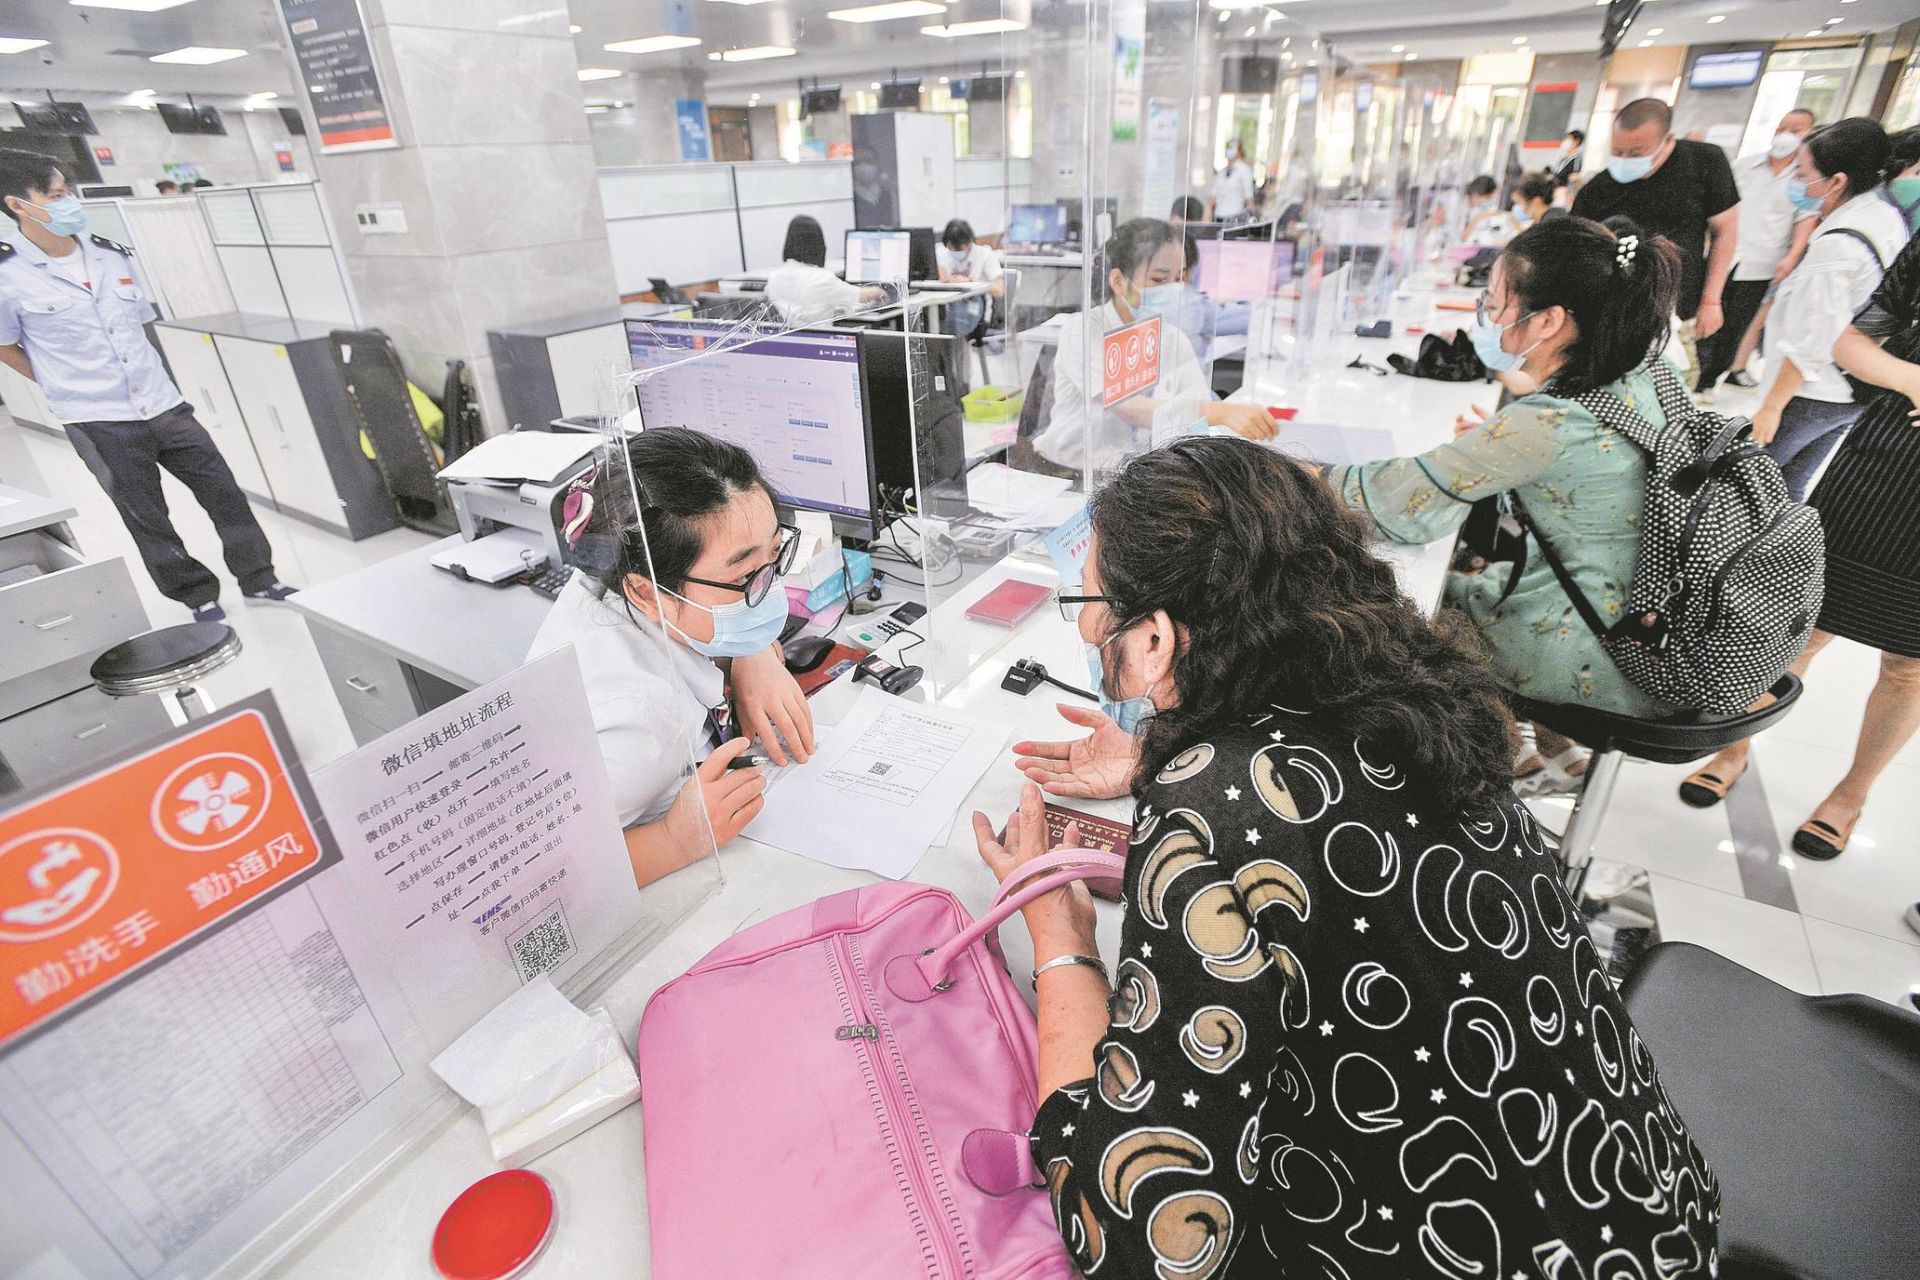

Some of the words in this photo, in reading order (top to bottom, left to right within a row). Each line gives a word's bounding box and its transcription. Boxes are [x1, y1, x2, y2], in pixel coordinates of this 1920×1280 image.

[381, 691, 515, 777] 微信填地址流程
[488, 758, 531, 789] 填写姓名
[356, 782, 421, 824] 微信扫一扫
[448, 731, 503, 770] 邮寄二维码
[365, 778, 463, 843] 微信用户快速登录
[489, 750, 511, 769] 允许
[187, 832, 304, 910] 勤通风
[397, 856, 444, 893] 选择地区
[431, 885, 463, 915] 点保存
[448, 909, 461, 922] 址
[481, 866, 521, 899] 点我下单
[543, 835, 563, 854] 退出
[480, 868, 567, 936] 客户微信扫码寄快递
[15, 908, 160, 1005] 勤洗手
